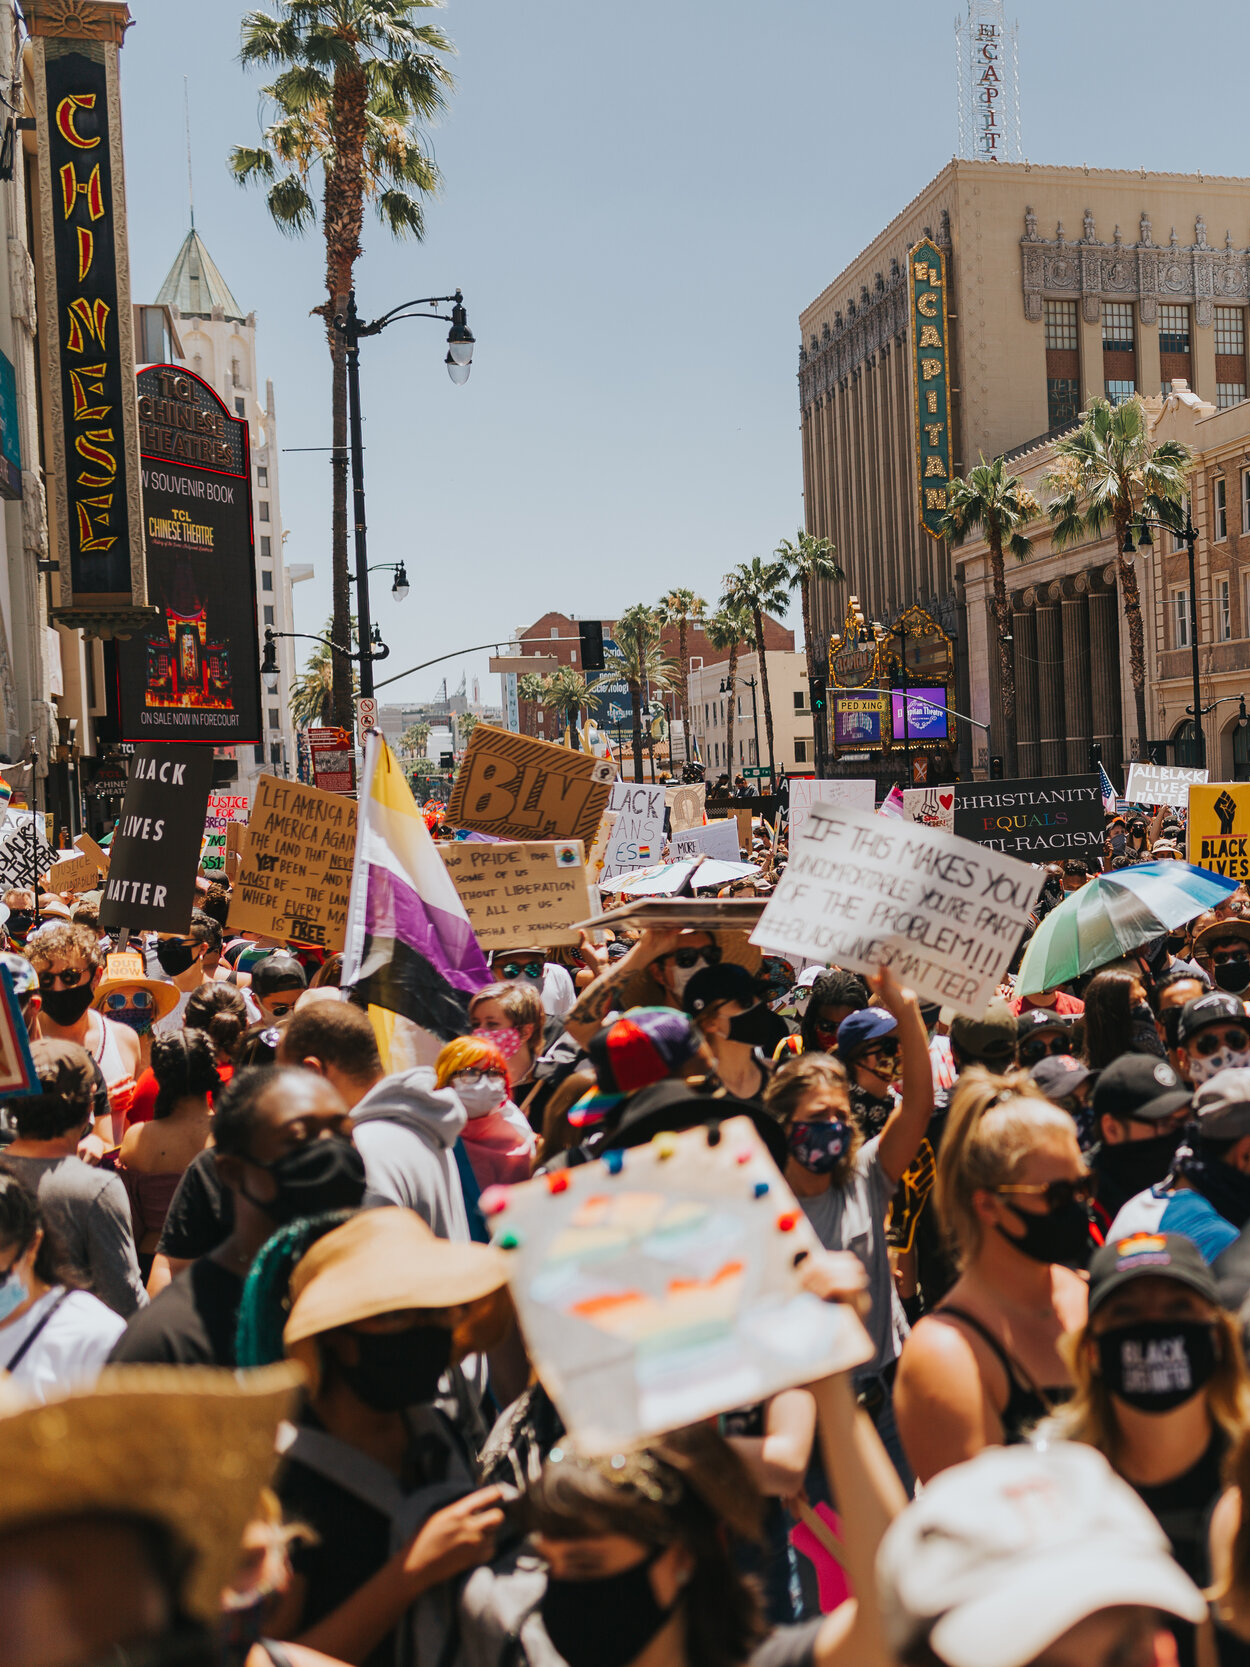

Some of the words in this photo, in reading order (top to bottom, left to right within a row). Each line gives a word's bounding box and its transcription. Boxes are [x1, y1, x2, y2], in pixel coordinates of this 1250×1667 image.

[979, 24, 1000, 38] EL
[914, 261, 942, 287] EL
[56, 93, 118, 552] CHINESE
[161, 371, 201, 405] TCL
[917, 291, 947, 510] CAPITAN
[137, 395, 225, 439] CHINESE
[151, 470, 205, 498] SOUVENIR
[207, 483, 234, 504] BOOK
[172, 509, 192, 522] TCL
[149, 517, 182, 541] CHINESE
[182, 522, 215, 546] THEATRE
[841, 702, 859, 710] PED
[862, 702, 883, 710] XING
[141, 712, 153, 725] ON
[153, 712, 172, 725] SALE
[173, 712, 191, 725] NOW
[192, 713, 199, 726] IN
[200, 714, 239, 726] FORECOURT
[1134, 766, 1160, 779] ALL
[1160, 769, 1205, 783] BLACK
[459, 752, 595, 837] BLM
[1145, 780, 1190, 793] LIVES
[207, 795, 248, 808] JUSTICE
[290, 791, 343, 827] AMERICA
[953, 787, 1099, 811] CHRISTIANITY
[215, 809, 235, 818] FOR
[983, 811, 1068, 833] EQUALS
[264, 812, 319, 844] AMERICA
[250, 831, 270, 849] THE
[275, 838, 302, 858] LAND
[304, 844, 328, 862] THAT
[677, 840, 697, 854] MORE
[1201, 838, 1248, 859] BLACK
[471, 851, 521, 867] PRIDE
[530, 852, 551, 861] FOR
[802, 815, 848, 842] IF
[850, 825, 897, 859] THIS
[897, 840, 979, 890] MAKES
[982, 867, 1035, 913] YOU
[279, 858, 307, 877] BEEN
[321, 871, 344, 888] AND
[456, 873, 485, 883] SOME
[495, 870, 508, 879] OF
[515, 869, 528, 877] US
[238, 870, 271, 891] MUST
[273, 879, 289, 892] BE
[305, 886, 324, 902] THE
[504, 880, 576, 897] LIBERATION
[242, 887, 278, 909] WHERE
[282, 900, 322, 921] EVERY
[486, 905, 506, 917] ALL
[517, 903, 531, 912] OF
[272, 916, 285, 932] IS
[821, 889, 863, 921] THE
[868, 900, 1003, 978] PROBLEM!!!
[974, 905, 1026, 943] PART
[110, 967, 141, 977] NOW
[111, 958, 139, 968] OUT
